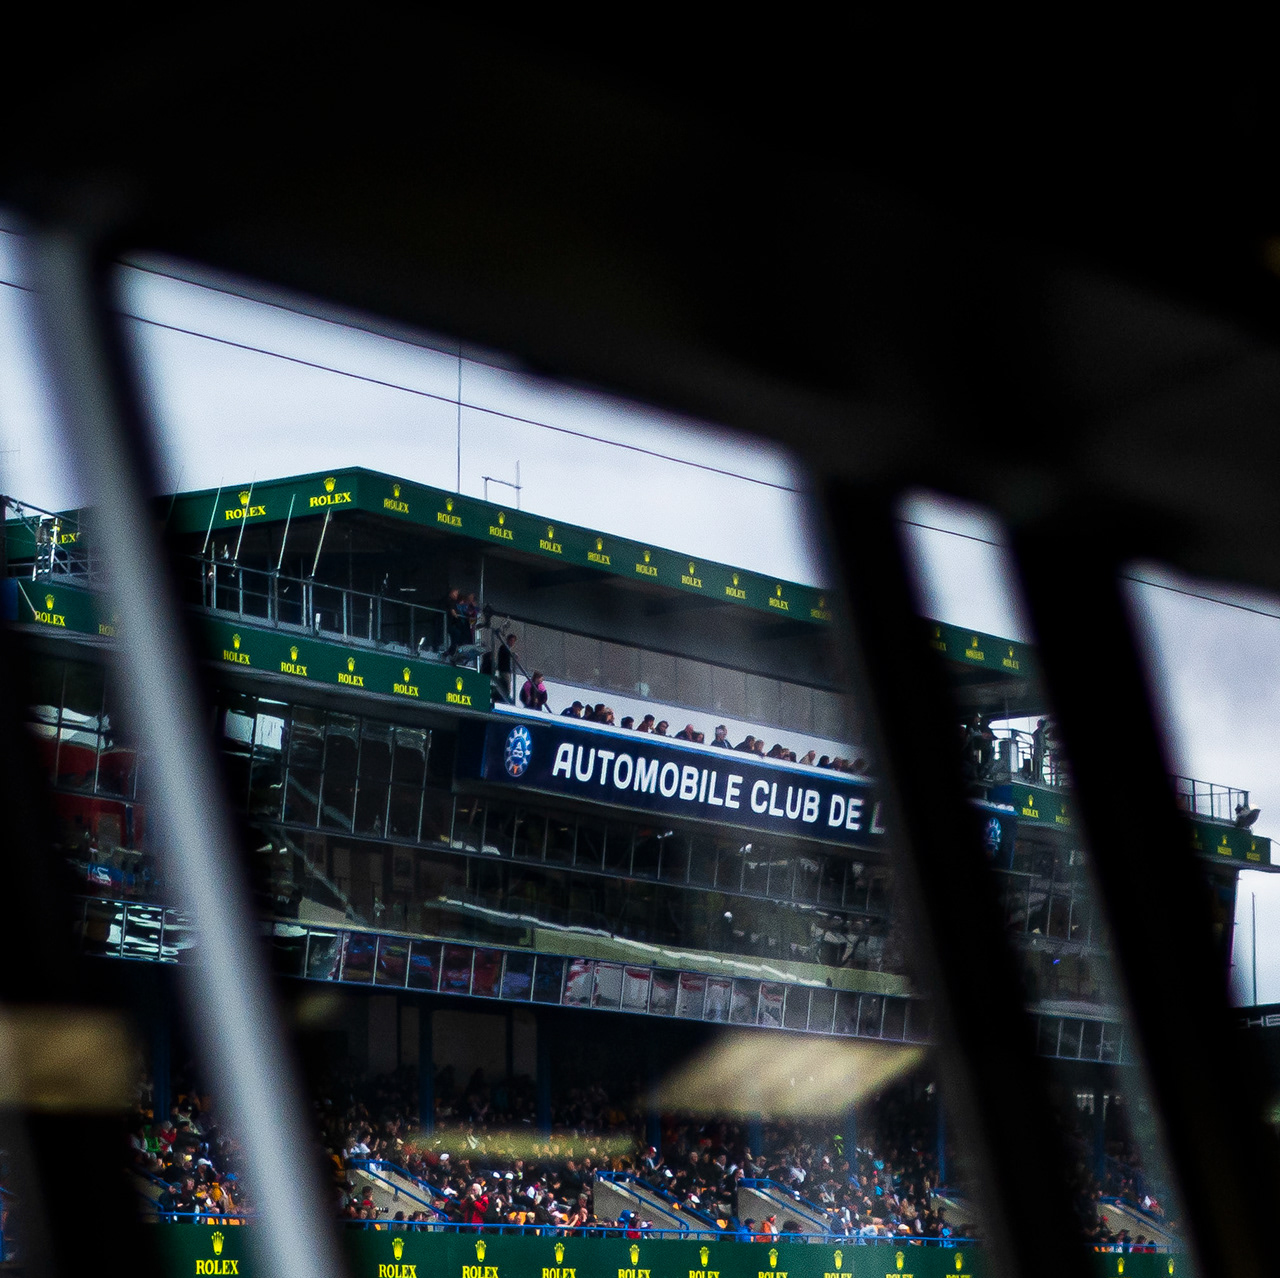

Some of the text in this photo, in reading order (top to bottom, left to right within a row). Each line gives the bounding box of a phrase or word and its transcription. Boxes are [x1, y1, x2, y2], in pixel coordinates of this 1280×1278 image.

[310, 492, 352, 507] ROLEX
[225, 505, 266, 520] ROLEX
[490, 526, 513, 540] ROLEX
[540, 539, 562, 554] ROLEX
[223, 649, 251, 665] ROLEX
[281, 662, 307, 677] ROLEX
[338, 672, 364, 687] ROLEX
[394, 683, 419, 697] ROLEX
[446, 692, 472, 706] ROLEX
[552, 742, 742, 809] AUTOMOBILE
[749, 779, 820, 824] CLUB
[828, 793, 863, 831] DE
[196, 1260, 239, 1276] ROLEX
[378, 1264, 417, 1278] ROLEX
